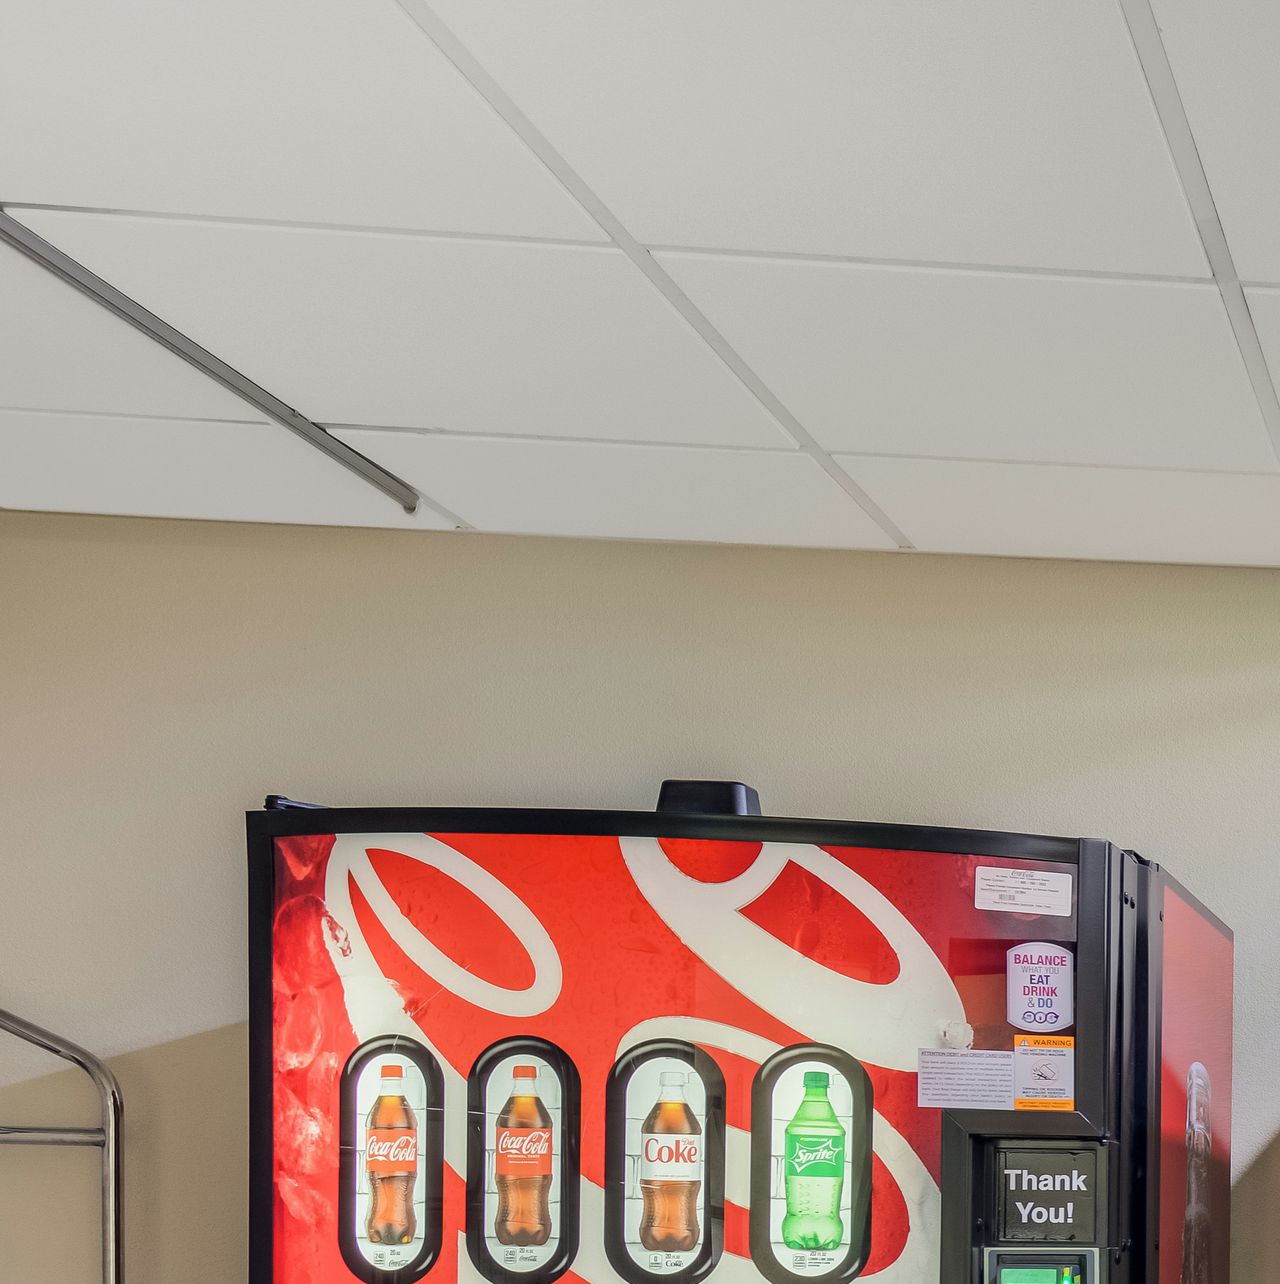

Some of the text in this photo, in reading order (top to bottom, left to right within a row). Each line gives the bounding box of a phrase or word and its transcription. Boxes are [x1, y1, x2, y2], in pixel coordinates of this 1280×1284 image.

[1014, 954, 1067, 966] BALANCE
[1021, 966, 1060, 975] WHAT YOU
[1029, 974, 1051, 985] EAT
[1023, 985, 1058, 997] DRINK
[1027, 997, 1053, 1008] & DO
[1033, 1039, 1072, 1047] WARNING
[366, 1135, 416, 1162] Coca-Cola
[498, 1130, 551, 1155] Coca-Cola
[644, 1137, 698, 1164] Coke
[794, 1147, 834, 1165] Sprite
[1003, 1169, 1088, 1192] Thank
[1015, 1202, 1075, 1224] You!
